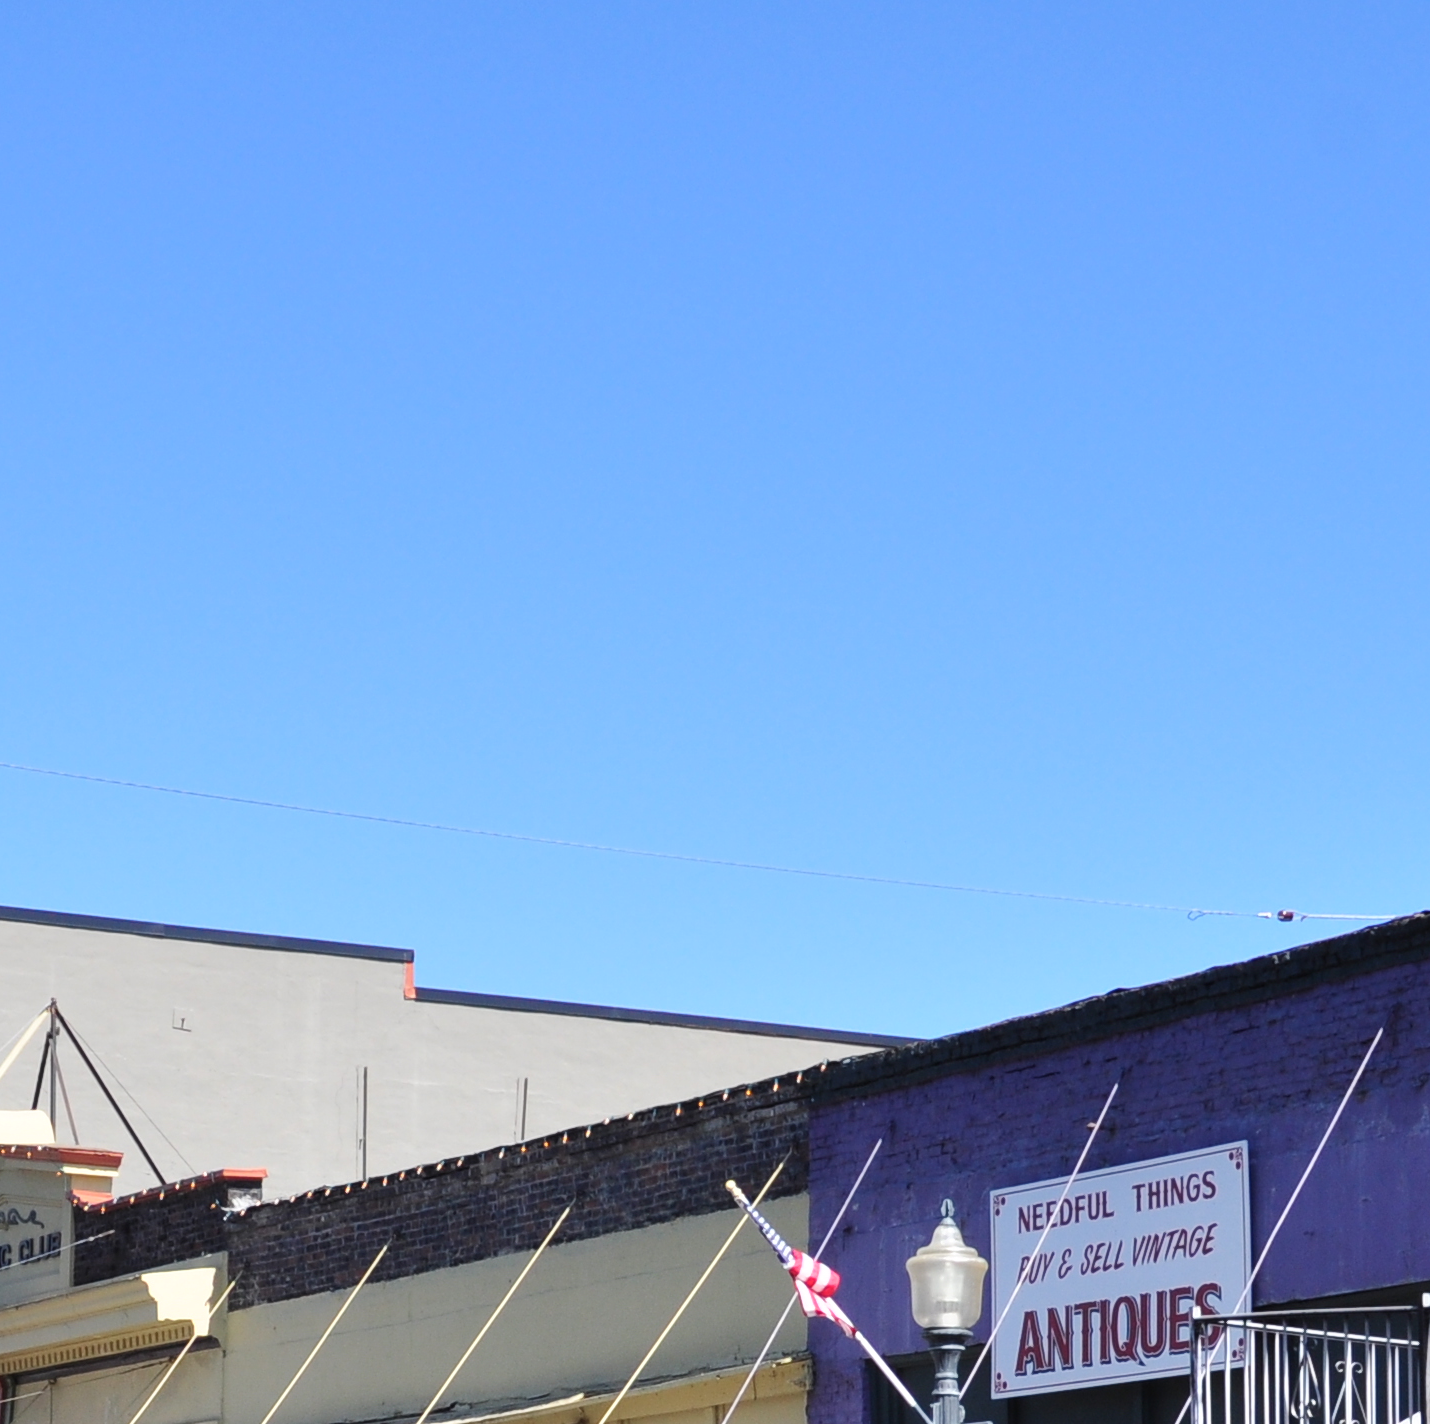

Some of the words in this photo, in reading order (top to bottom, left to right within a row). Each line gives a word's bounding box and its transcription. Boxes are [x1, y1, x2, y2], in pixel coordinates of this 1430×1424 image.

[1018, 1190, 1114, 1234] NEEDFUL
[1132, 1170, 1217, 1212] THINGS
[19, 1231, 61, 1266] CLUB
[1017, 1249, 1055, 1285] BUY
[1058, 1248, 1073, 1279] &
[1081, 1240, 1124, 1275] SELL
[1132, 1223, 1218, 1266] VINTAGE
[1015, 1283, 1222, 1377] ANTIQUES
